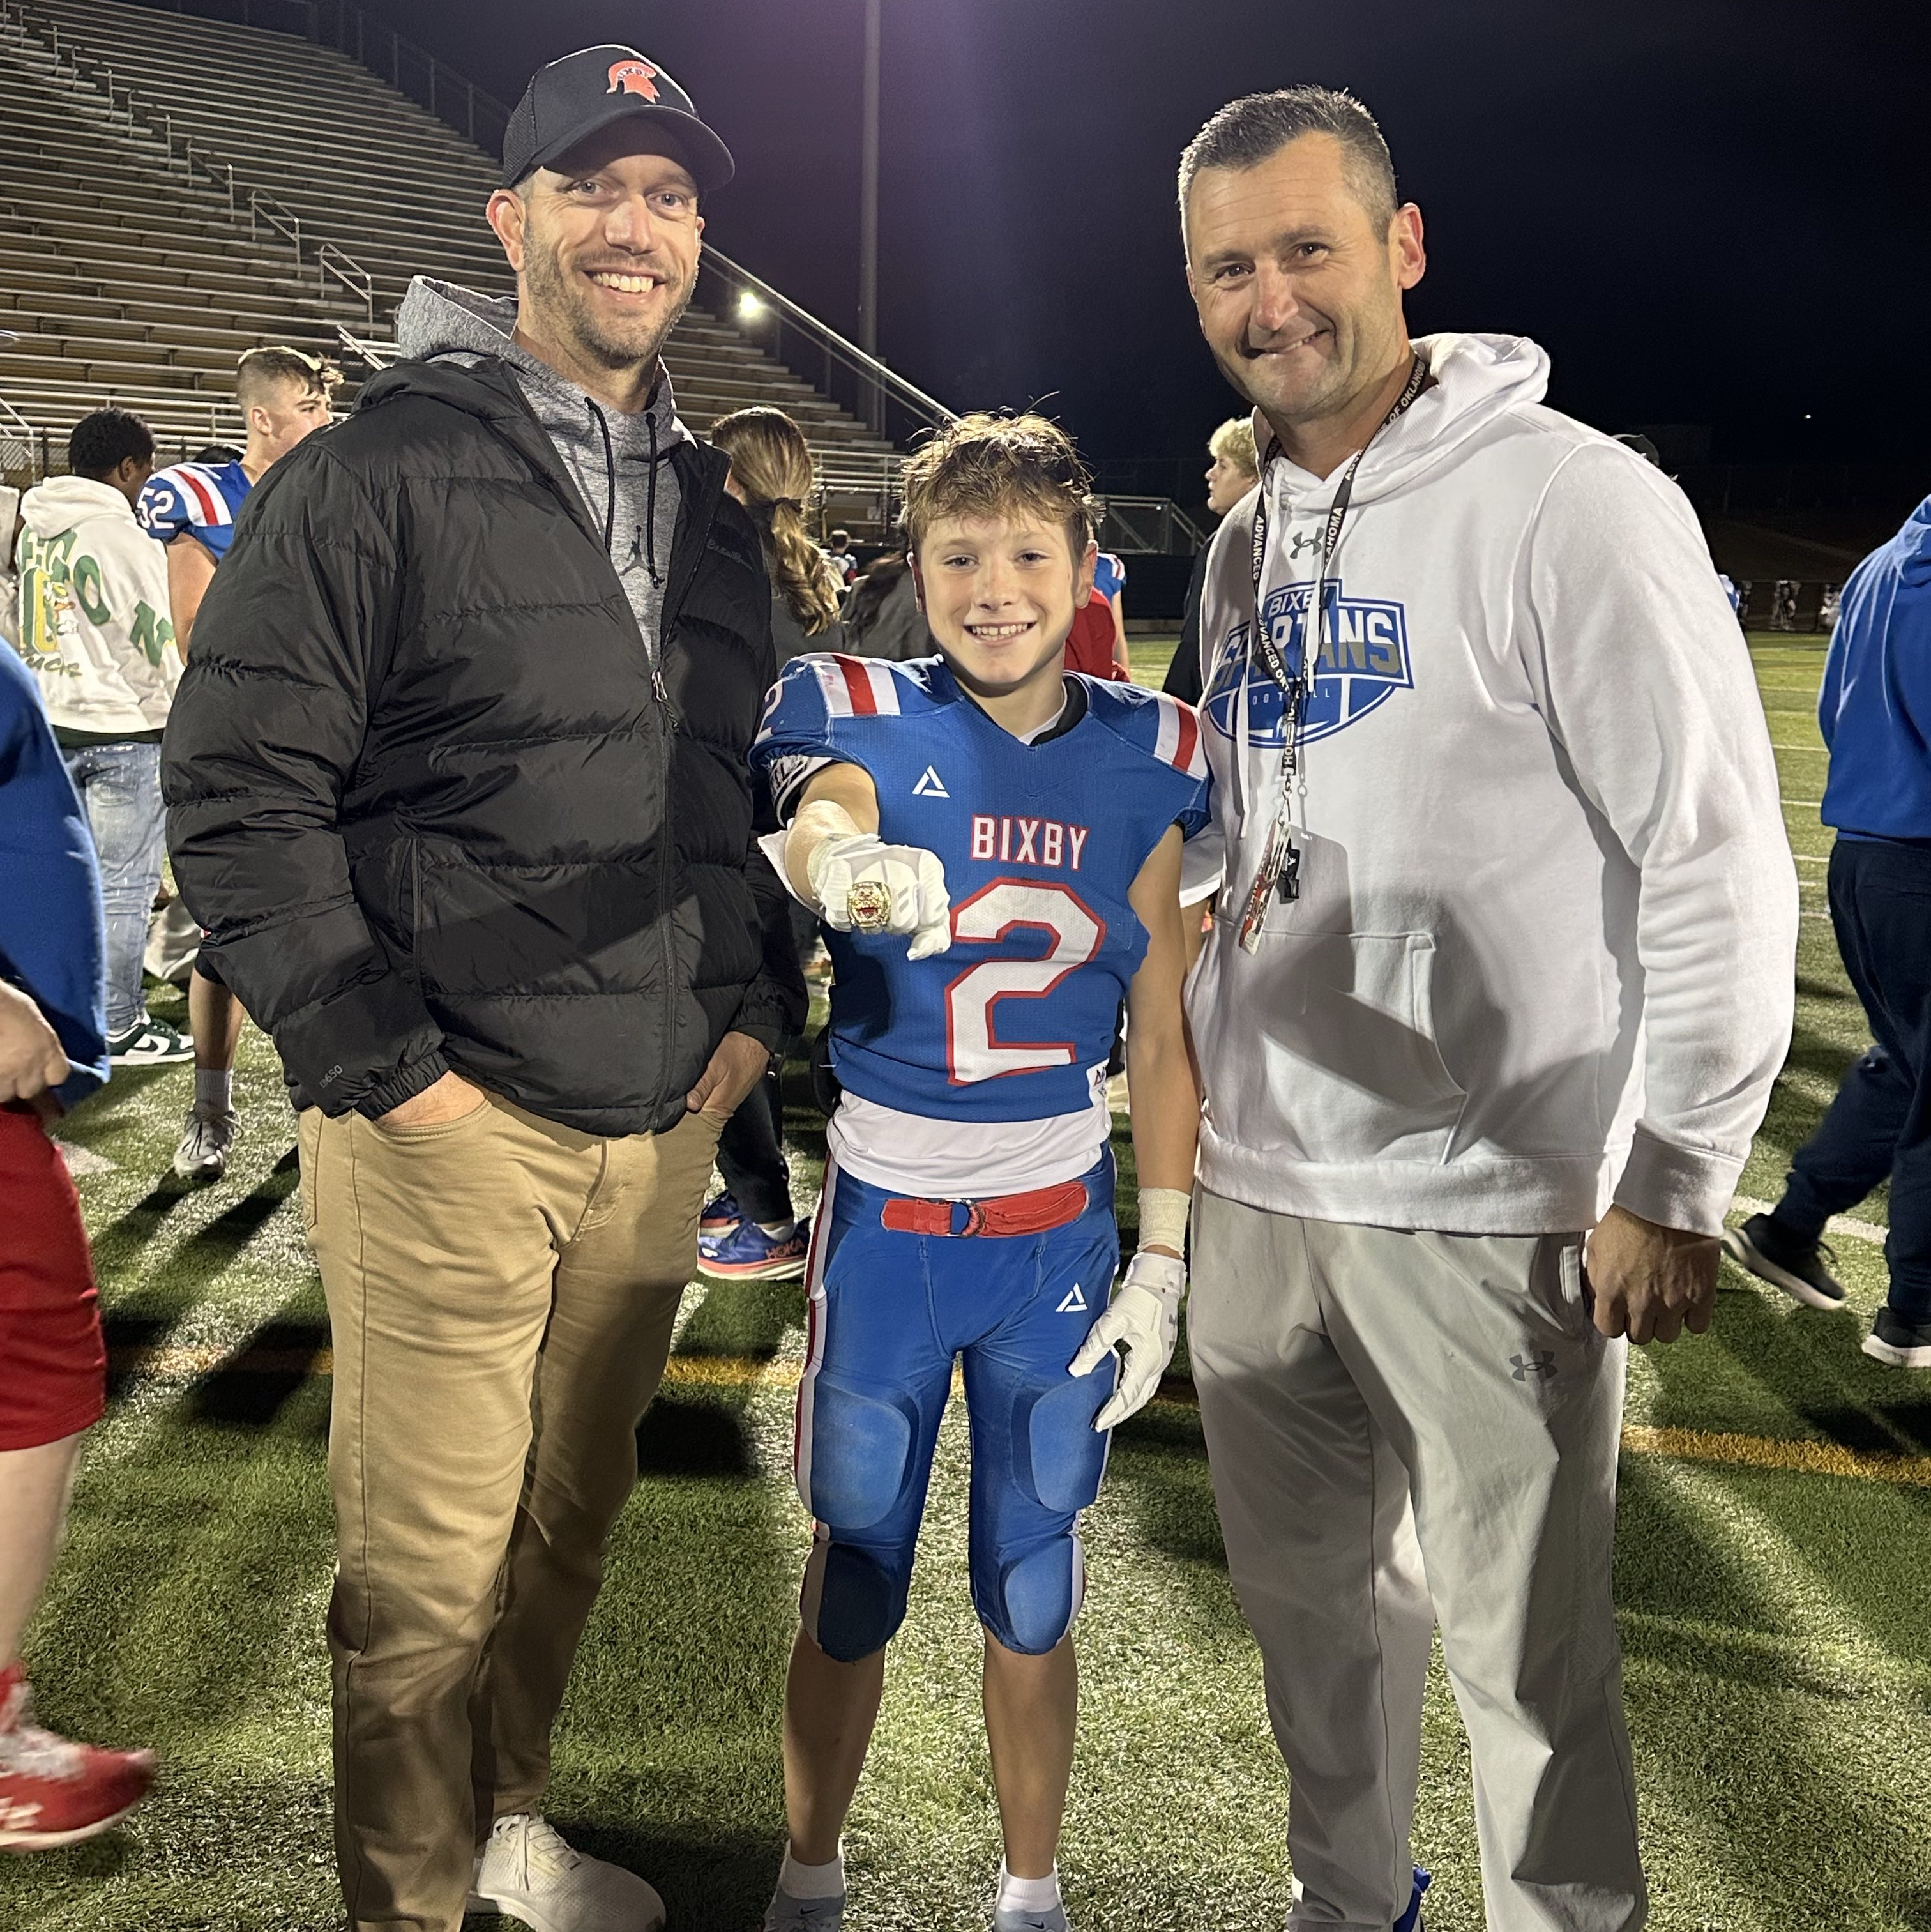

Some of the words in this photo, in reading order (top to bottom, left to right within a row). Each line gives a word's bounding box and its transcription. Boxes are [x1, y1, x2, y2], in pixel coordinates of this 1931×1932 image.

[1388, 406, 1400, 423] OF
[137, 487, 174, 529] 52
[1252, 515, 1265, 581] ADVANCED
[971, 814, 1089, 871] BIXBY
[944, 876, 1107, 1086] 2
